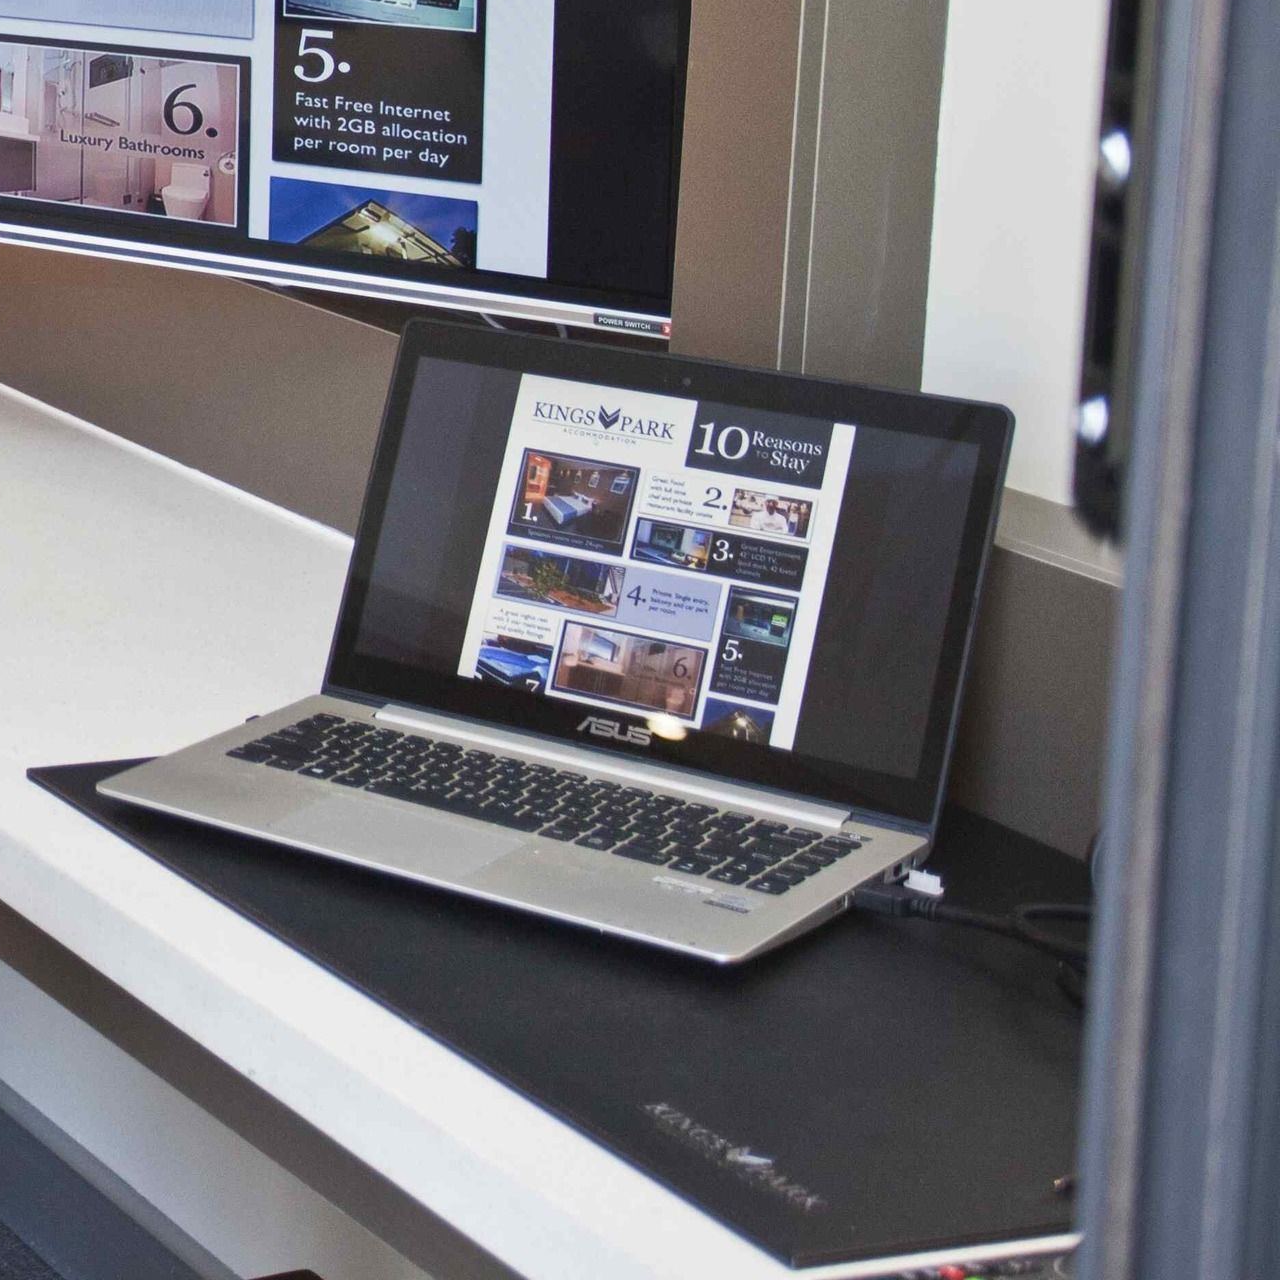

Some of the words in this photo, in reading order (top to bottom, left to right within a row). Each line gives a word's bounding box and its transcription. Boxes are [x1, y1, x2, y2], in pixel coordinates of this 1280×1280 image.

[293, 28, 351, 83] 5.
[163, 83, 219, 138] 6.
[295, 92, 329, 109] Fast
[335, 96, 373, 114] Free
[379, 101, 451, 122] Internet
[60, 128, 114, 152] Luxury
[118, 135, 205, 160] Bathrooms
[294, 114, 331, 131] with
[337, 117, 376, 135] 2GB
[381, 124, 468, 145] allocation
[294, 136, 322, 151] per
[328, 139, 377, 157] room
[383, 147, 412, 162] per
[419, 147, 450, 168] day
[598, 316, 623, 327] POWER
[624, 319, 651, 330] SWITCH
[533, 401, 596, 426] KINGS
[619, 416, 676, 440] PARK
[694, 422, 750, 460] 10
[752, 430, 823, 456] Reasons
[770, 450, 810, 474] Stay
[522, 502, 538, 522] 1.
[702, 486, 728, 511] 2.
[712, 539, 734, 562] 3.
[626, 585, 647, 607] 4.
[722, 639, 743, 662] 5.
[673, 656, 692, 680] 6.
[576, 716, 653, 747] ASUS
